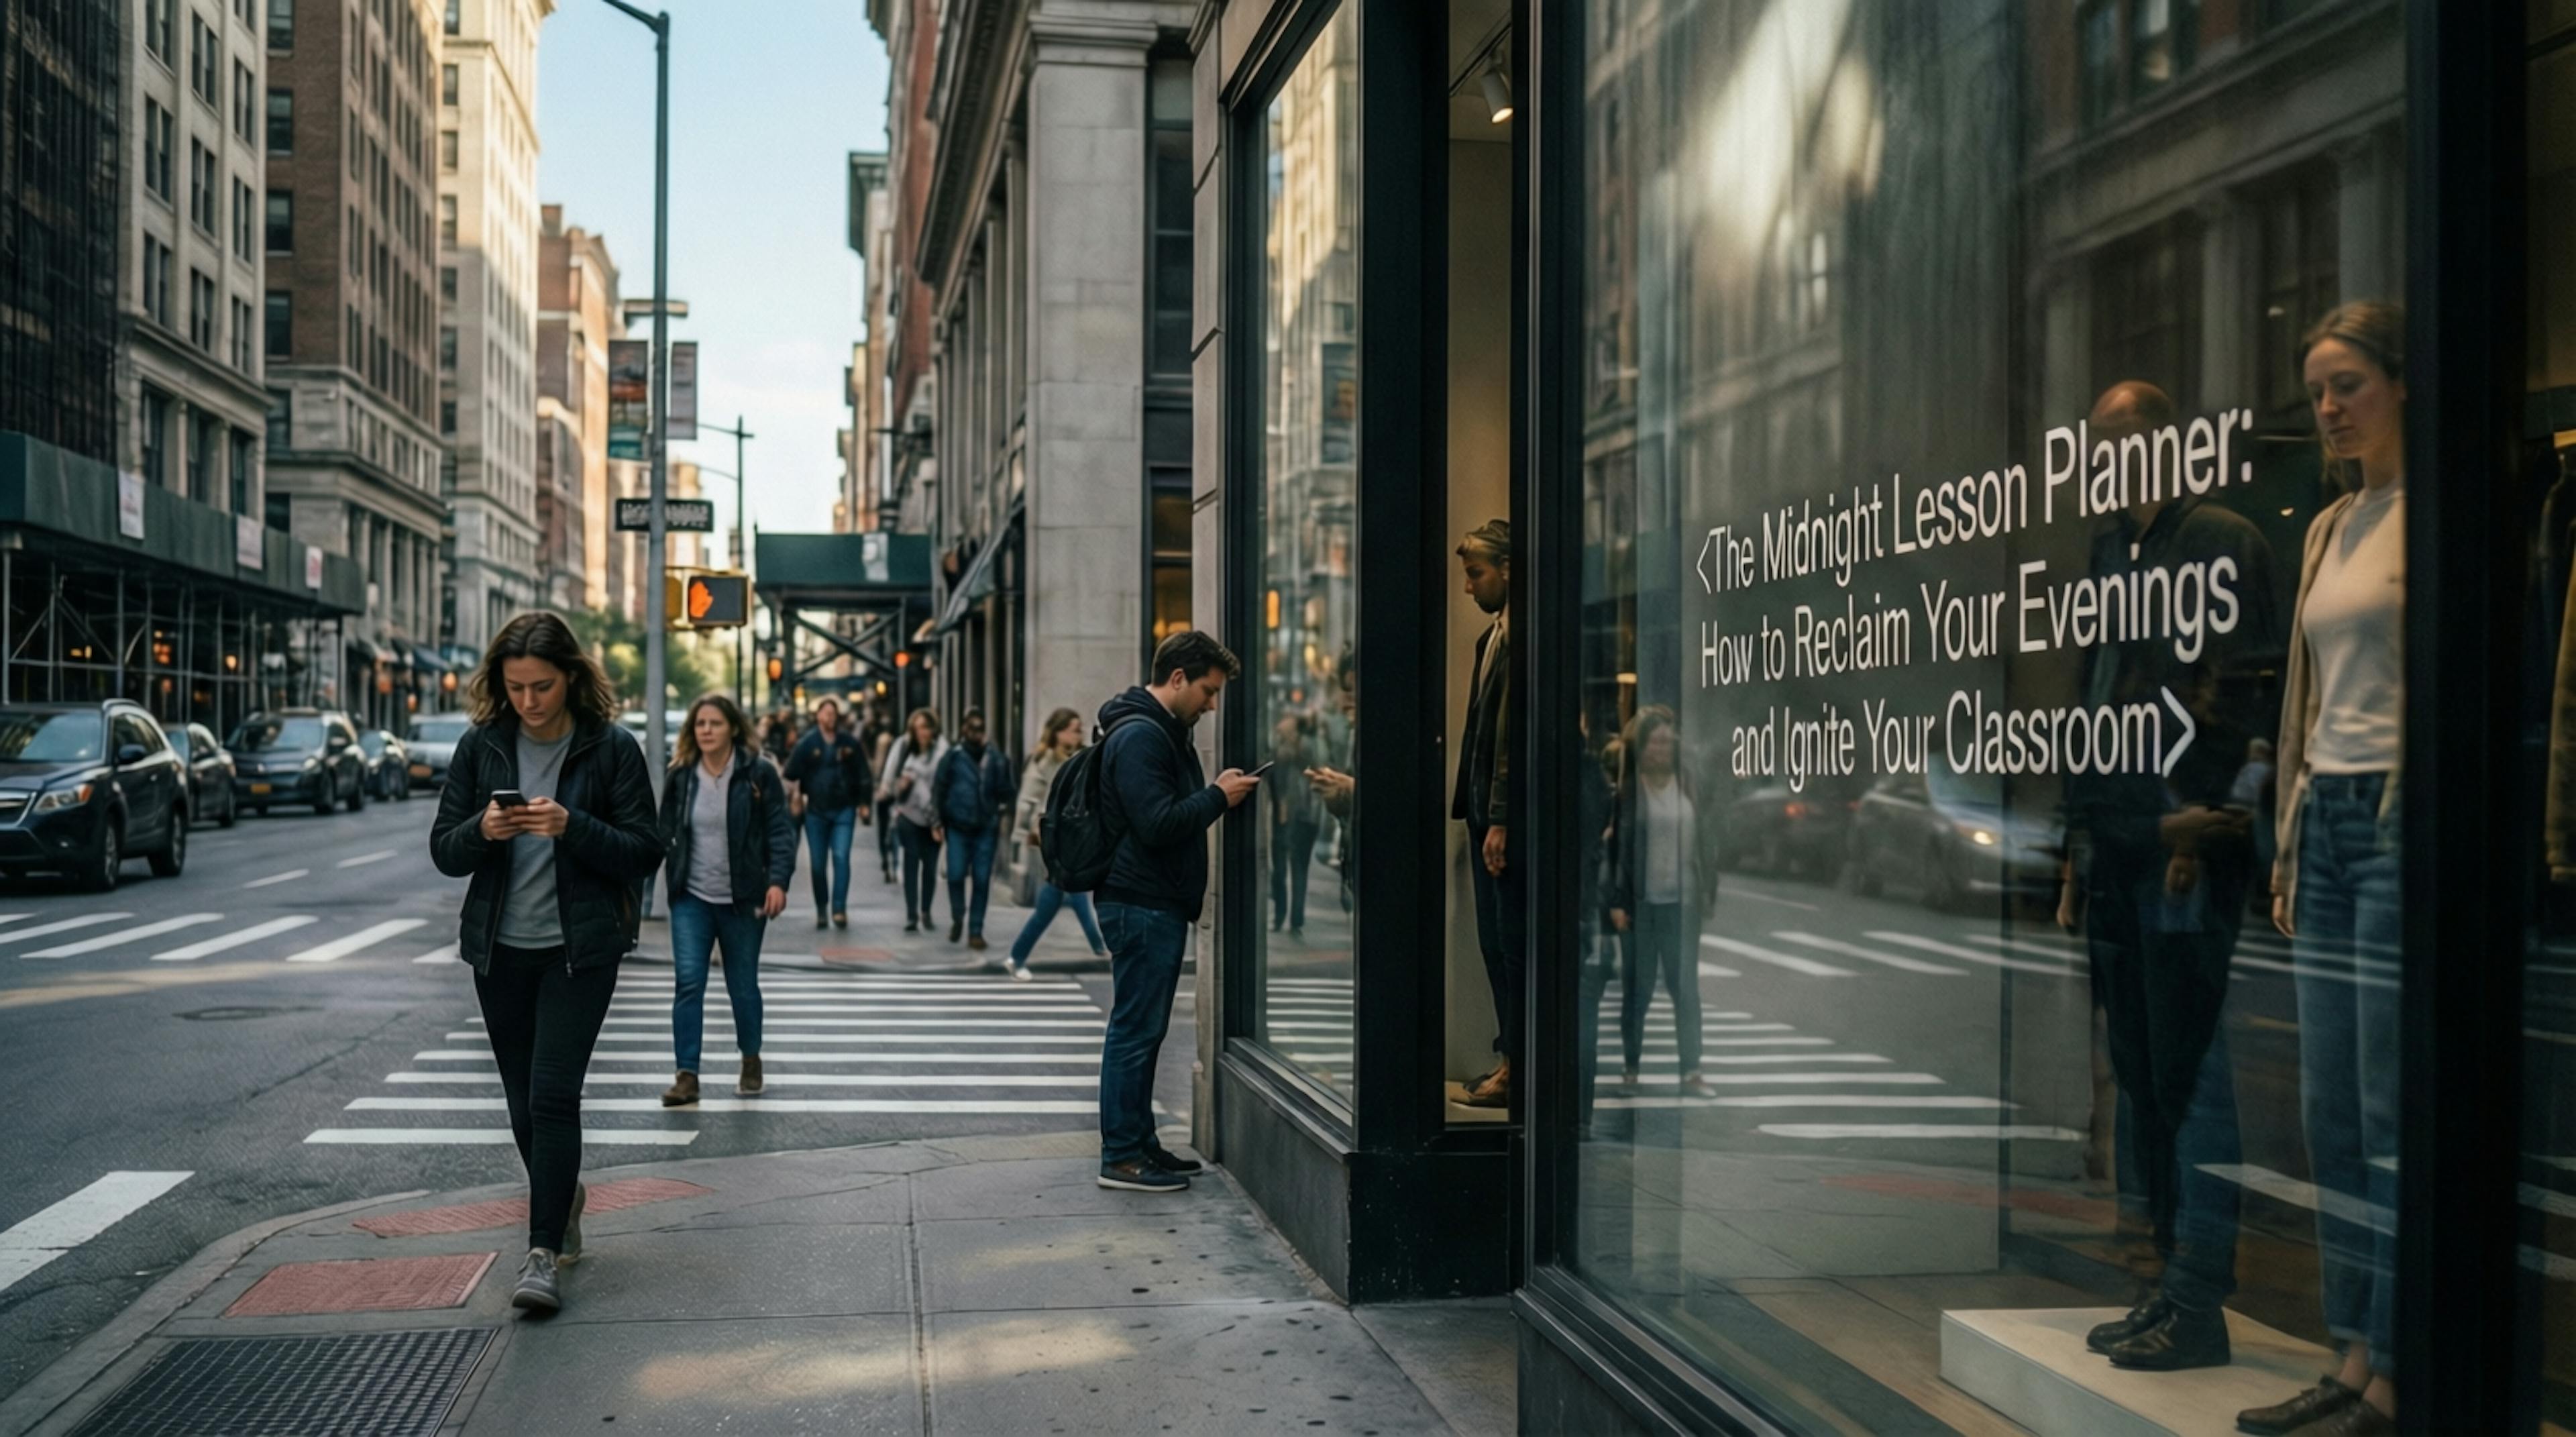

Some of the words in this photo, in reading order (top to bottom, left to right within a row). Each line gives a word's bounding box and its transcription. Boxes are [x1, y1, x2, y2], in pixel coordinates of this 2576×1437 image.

[1763, 484, 1884, 588] Midnight
[1894, 464, 2027, 554] Lesson
[2045, 408, 2253, 524] Planner:
[1702, 621, 1754, 688] How
[1760, 615, 1786, 681] to
[1794, 592, 1910, 678] Reclaim
[1920, 579, 2006, 663] Your
[2019, 543, 2239, 663] Evenings
[1731, 706, 1775, 777] and
[1784, 702, 1855, 794] Ignite
[1863, 698, 1935, 774] Your
